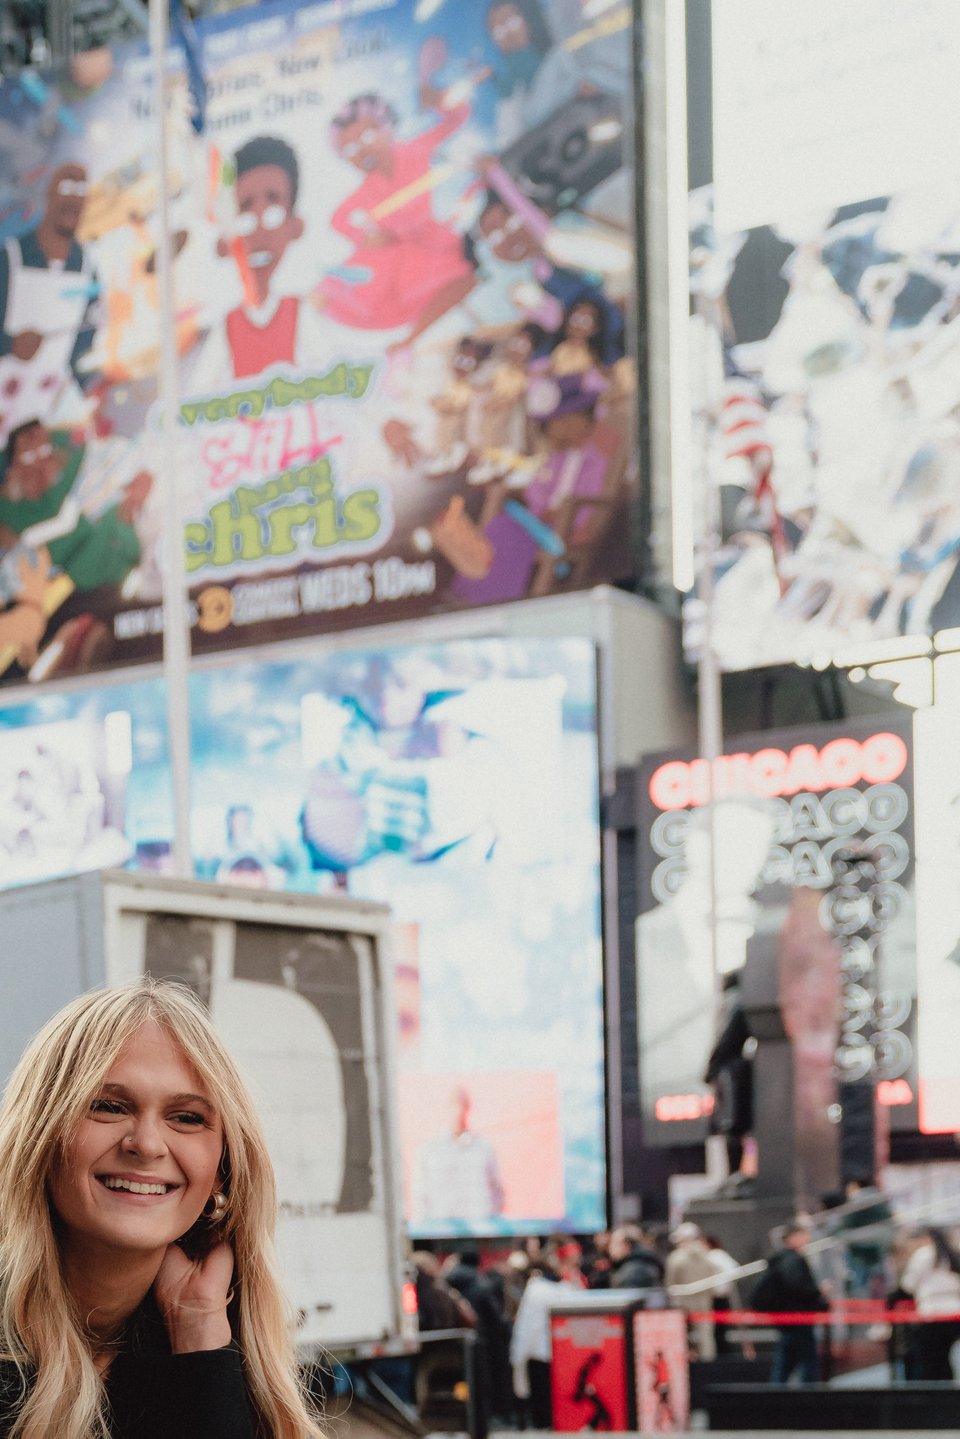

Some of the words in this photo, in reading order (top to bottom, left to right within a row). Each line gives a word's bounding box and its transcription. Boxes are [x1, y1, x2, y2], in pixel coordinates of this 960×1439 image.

[180, 362, 375, 426] verybody
[649, 732, 908, 811] CHICAGO
[650, 782, 909, 859] CCAGO
